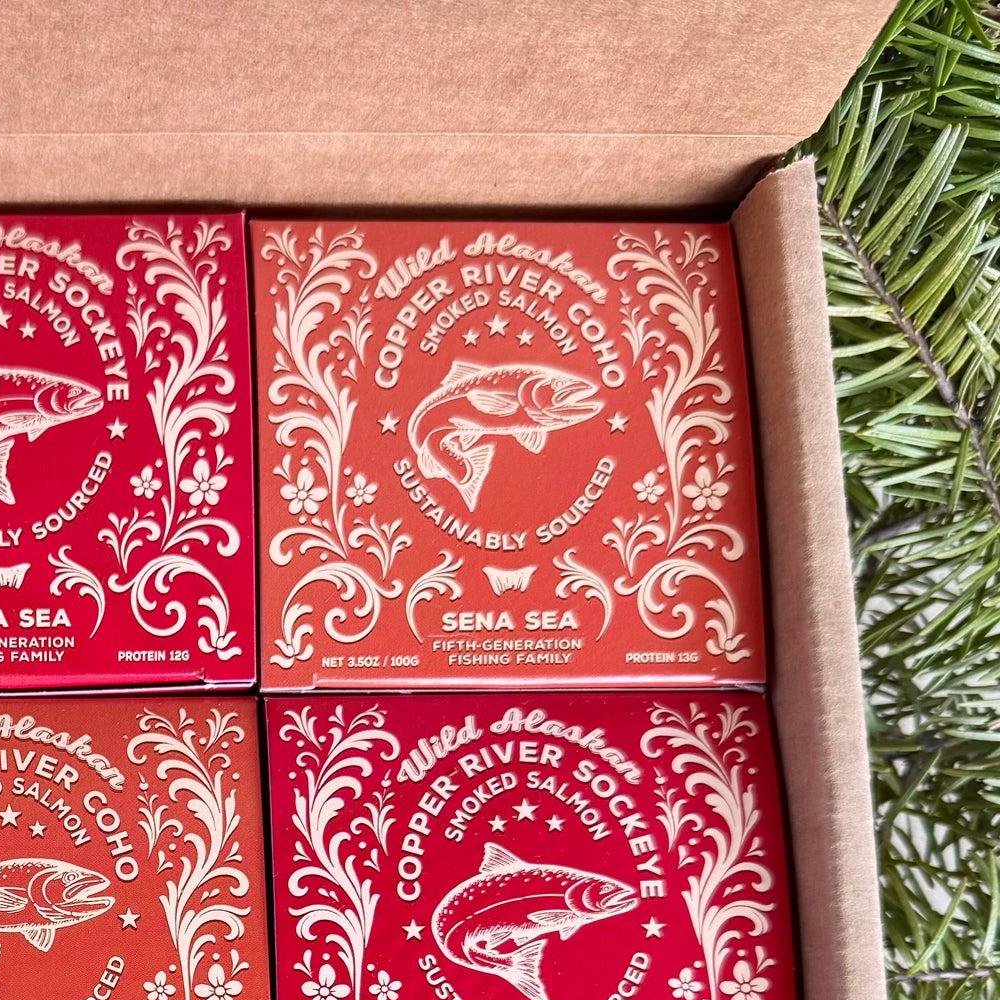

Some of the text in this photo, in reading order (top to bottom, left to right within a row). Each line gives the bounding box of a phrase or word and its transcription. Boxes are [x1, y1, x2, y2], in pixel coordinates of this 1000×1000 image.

[3, 281, 80, 347] SALMON
[48, 270, 130, 402] SOCKEYE
[374, 263, 626, 388] COPPER RIVER COHO
[419, 289, 578, 355] SMOKED SALMON
[32, 451, 112, 540] SOURCED
[393, 456, 616, 550] SUSTAINABLY SOURCED
[19, 608, 72, 628] SEA
[432, 638, 583, 652] FIFTH-GENERATION
[441, 610, 579, 632] SENA SEA
[10, 650, 65, 662] FAMILY
[117, 649, 190, 662] PROTEIN 12G
[321, 656, 345, 668] NET
[347, 655, 380, 668] 3.5OZ
[390, 655, 420, 667] 100G
[448, 652, 572, 665] FISHING FAMILY
[12, 777, 91, 846] SALMON
[83, 790, 139, 881] COHO
[396, 741, 665, 902] COPPER RIVER SOCKEYE
[444, 771, 611, 842] SMOKED SALMON
